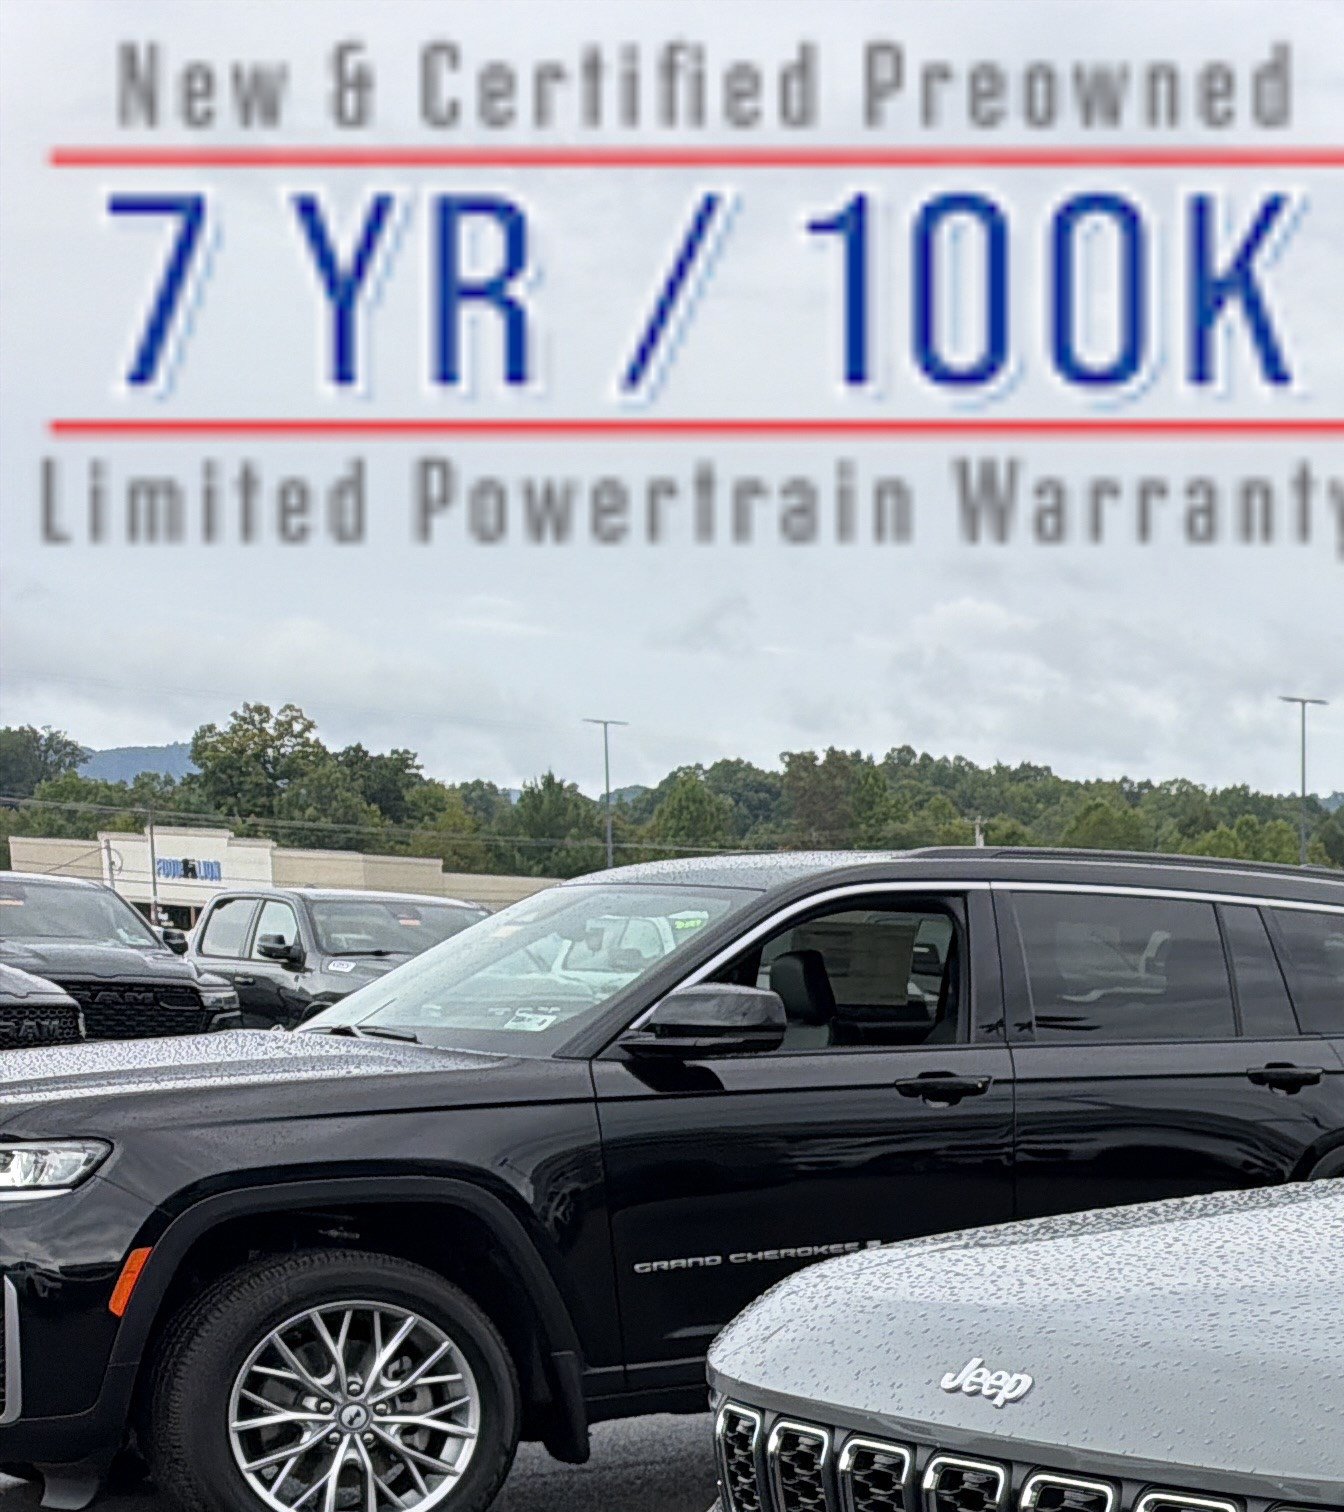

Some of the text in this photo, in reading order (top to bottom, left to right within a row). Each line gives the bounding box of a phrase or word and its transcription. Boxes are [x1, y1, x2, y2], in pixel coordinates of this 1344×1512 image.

[633, 1241, 860, 1274] GRAND CHEROKEE
[940, 1357, 1035, 1409] Jeep
